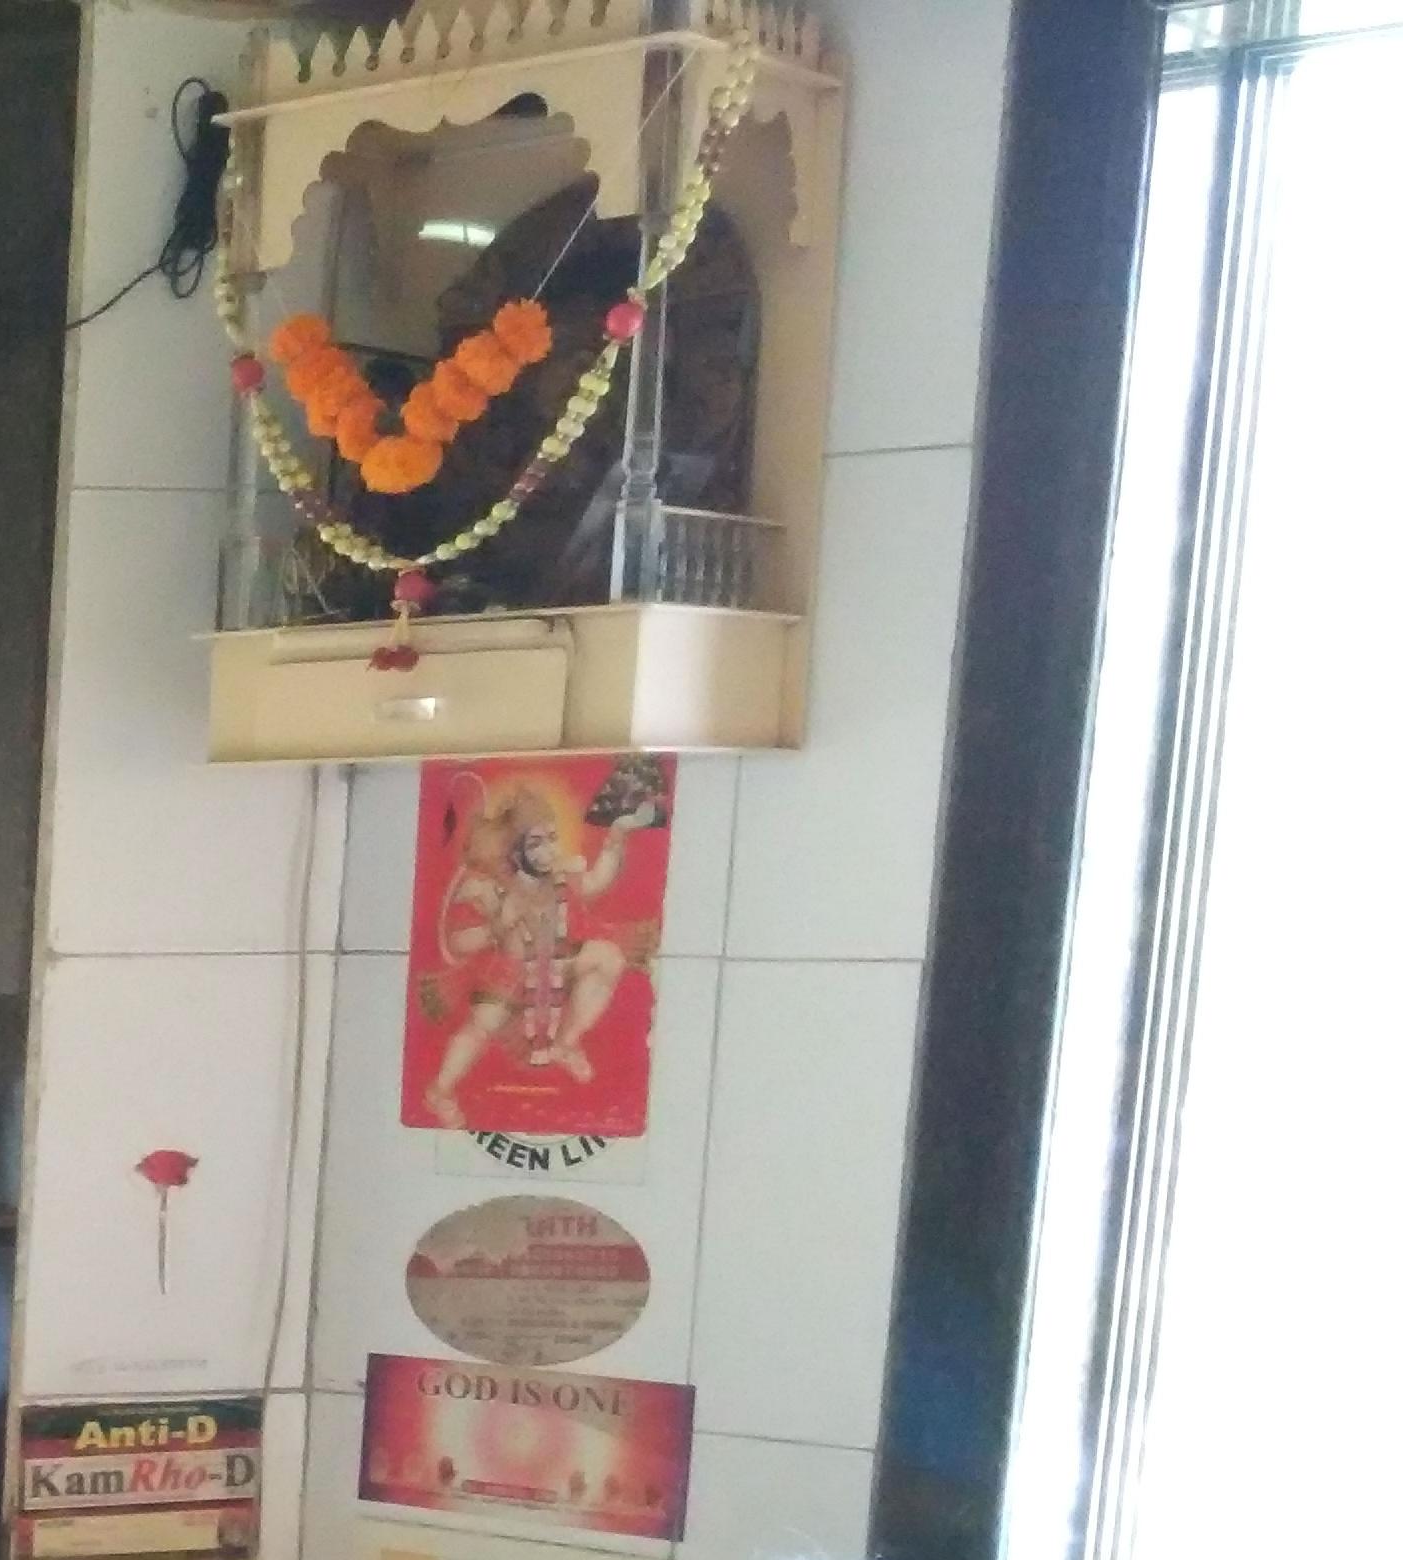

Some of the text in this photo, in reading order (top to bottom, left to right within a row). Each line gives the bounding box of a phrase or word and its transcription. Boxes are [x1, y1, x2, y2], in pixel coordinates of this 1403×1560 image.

[468, 1130, 550, 1171] REEN
[417, 1367, 631, 1416] GOD IS ONE
[74, 1415, 218, 1450] Anti-D
[31, 1453, 253, 1498] KamRho-D
